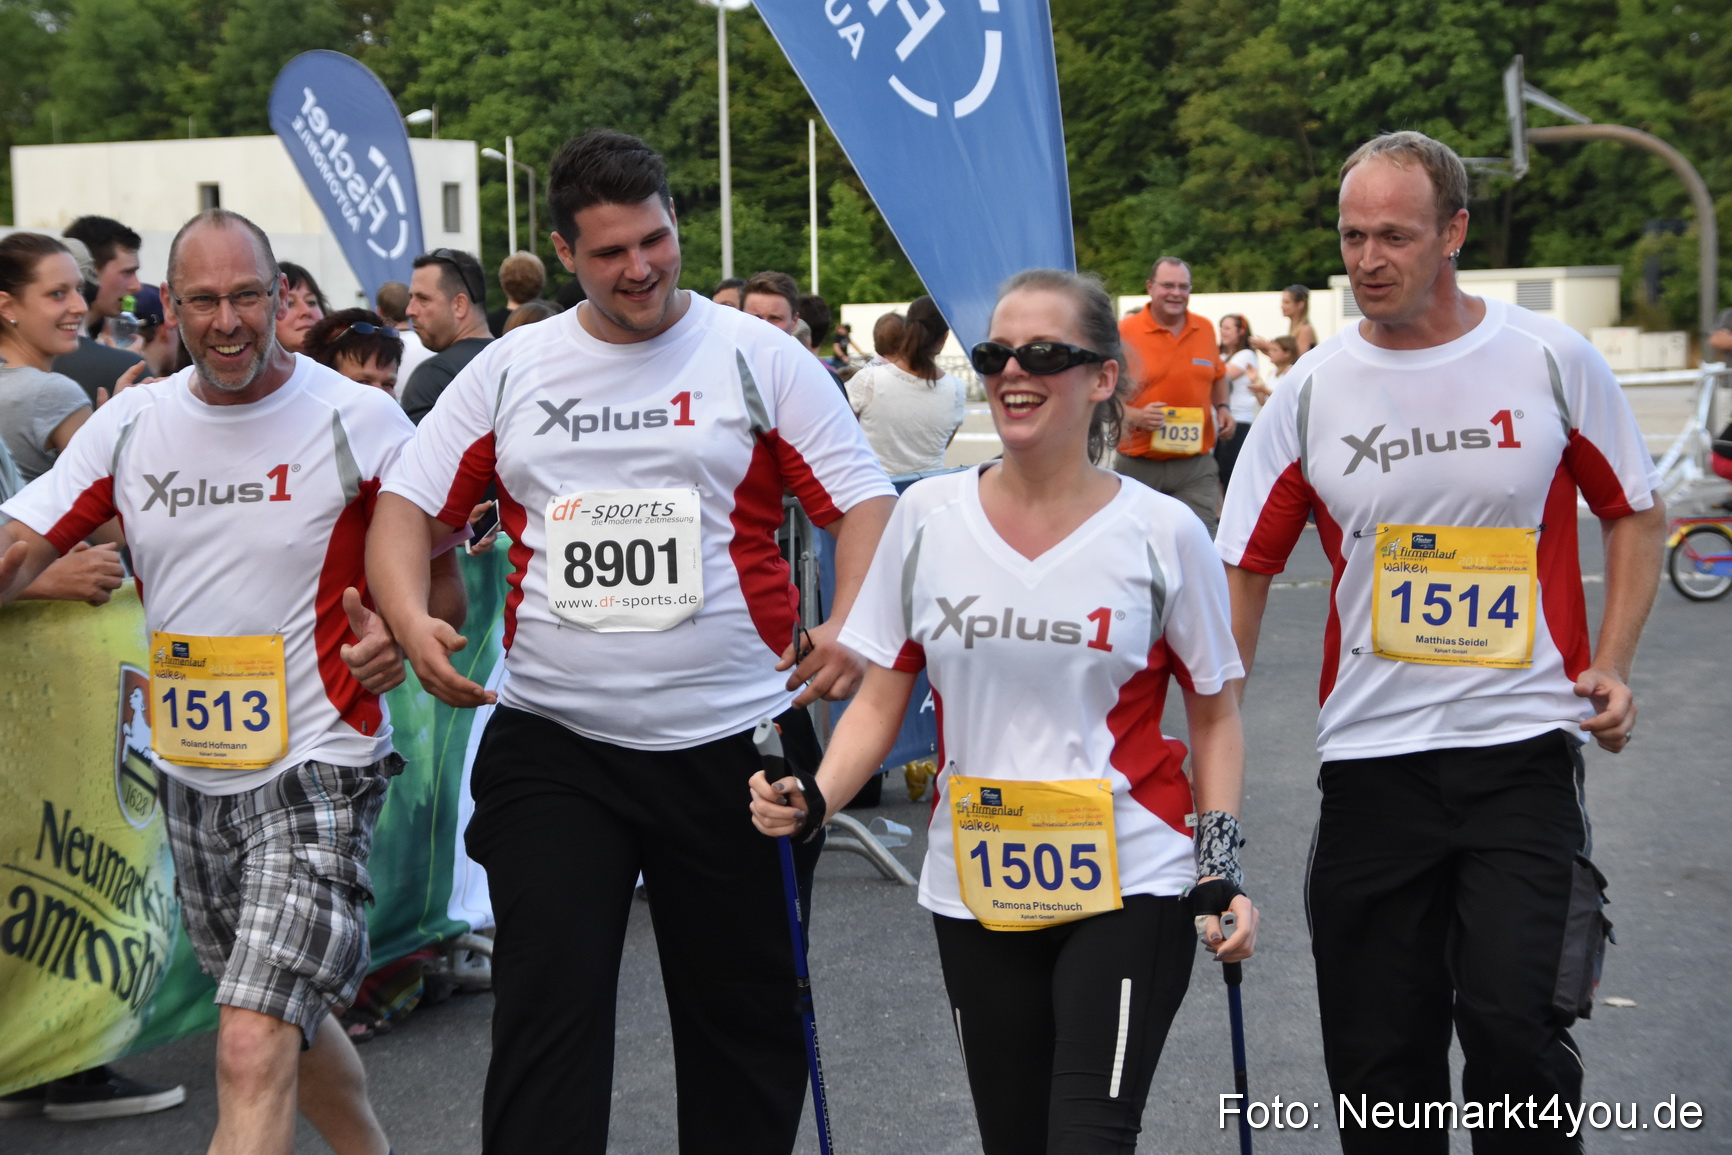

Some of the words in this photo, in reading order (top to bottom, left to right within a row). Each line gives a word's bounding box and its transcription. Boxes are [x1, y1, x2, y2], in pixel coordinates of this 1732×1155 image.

[1160, 425, 1199, 441] 1033
[552, 498, 675, 523] df-sports
[608, 517, 642, 525] moderne
[644, 515, 694, 524] Zeitmessung
[1399, 546, 1457, 560] firmenlauf
[564, 537, 678, 589] 8901
[1383, 561, 1428, 574] walken
[555, 593, 698, 609] www.df-sports.de
[1391, 580, 1519, 629] 1514
[1415, 635, 1457, 645] Matthias
[1458, 638, 1488, 647] Seidel
[165, 654, 207, 668] firmenlauf
[162, 687, 271, 732] 1513
[181, 738, 208, 749] Roland
[209, 741, 247, 750] Hofmann
[125, 784, 149, 817] 1628
[971, 803, 1024, 817] firmenlauf
[959, 819, 1001, 832] walken
[970, 841, 1102, 891] 1505
[992, 899, 1031, 910] Ramona
[1032, 902, 1083, 911] Pitschuch
